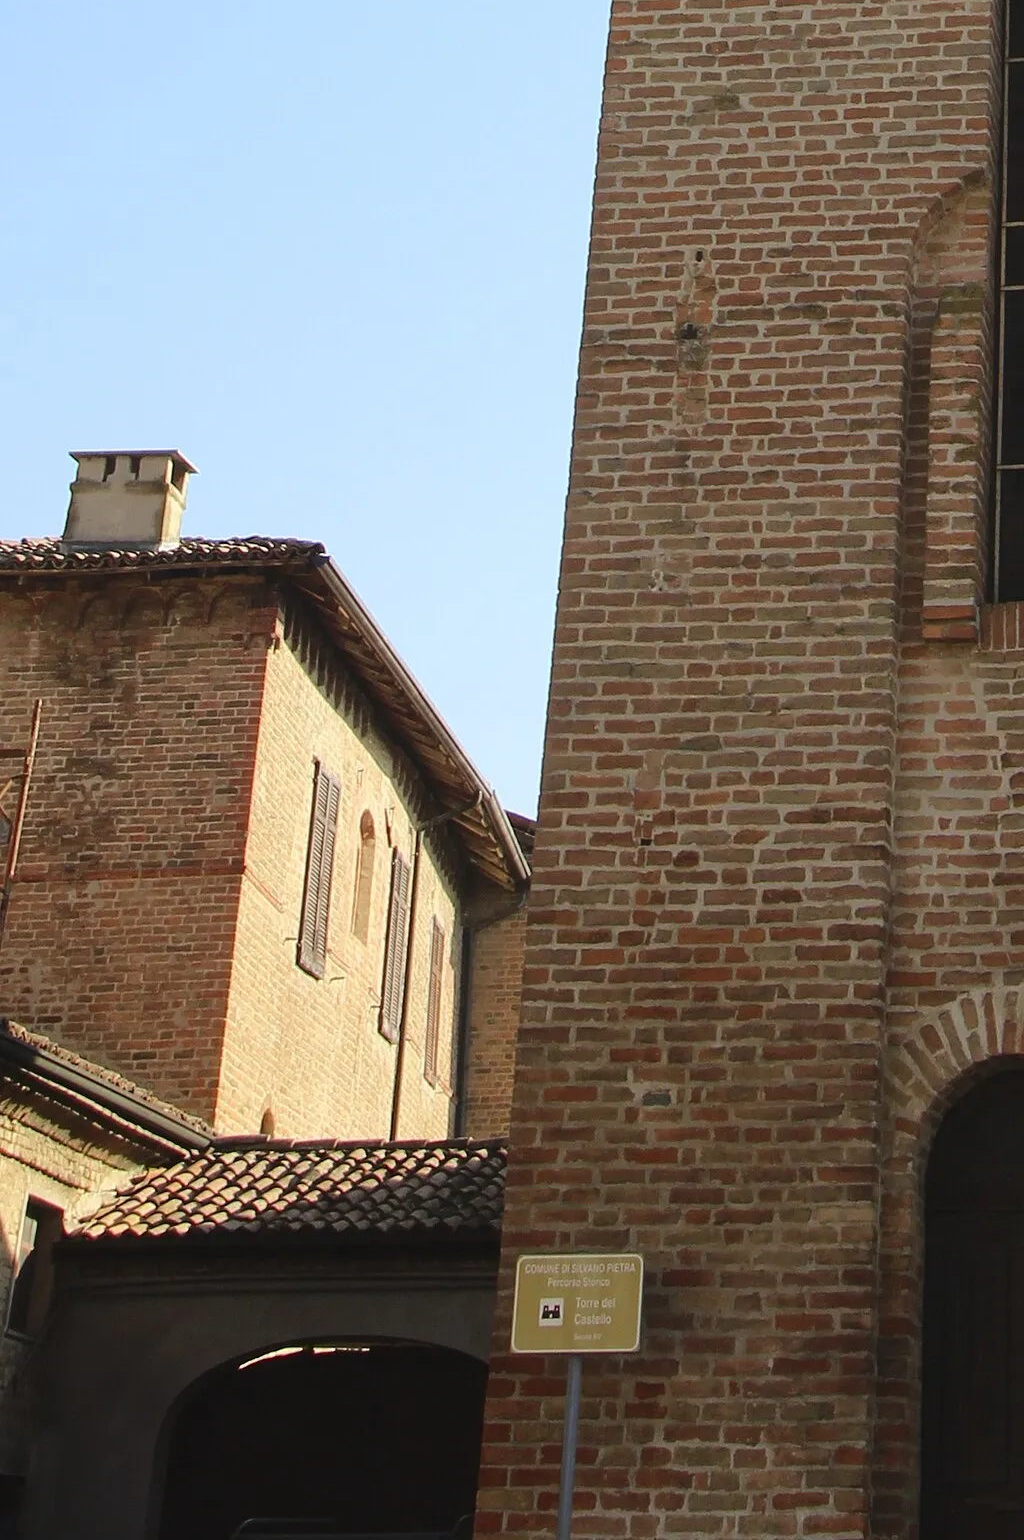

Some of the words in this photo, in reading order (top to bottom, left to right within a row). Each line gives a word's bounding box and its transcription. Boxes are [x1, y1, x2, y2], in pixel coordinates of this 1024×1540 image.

[525, 1264, 560, 1274] COMUNE
[562, 1264, 570, 1273] DI
[571, 1263, 605, 1273] SILVANO
[607, 1263, 636, 1273] PIETRA
[547, 1277, 582, 1287] Percorso
[575, 1297, 600, 1308] Torre
[601, 1296, 616, 1308] del
[574, 1313, 612, 1325] Castello
